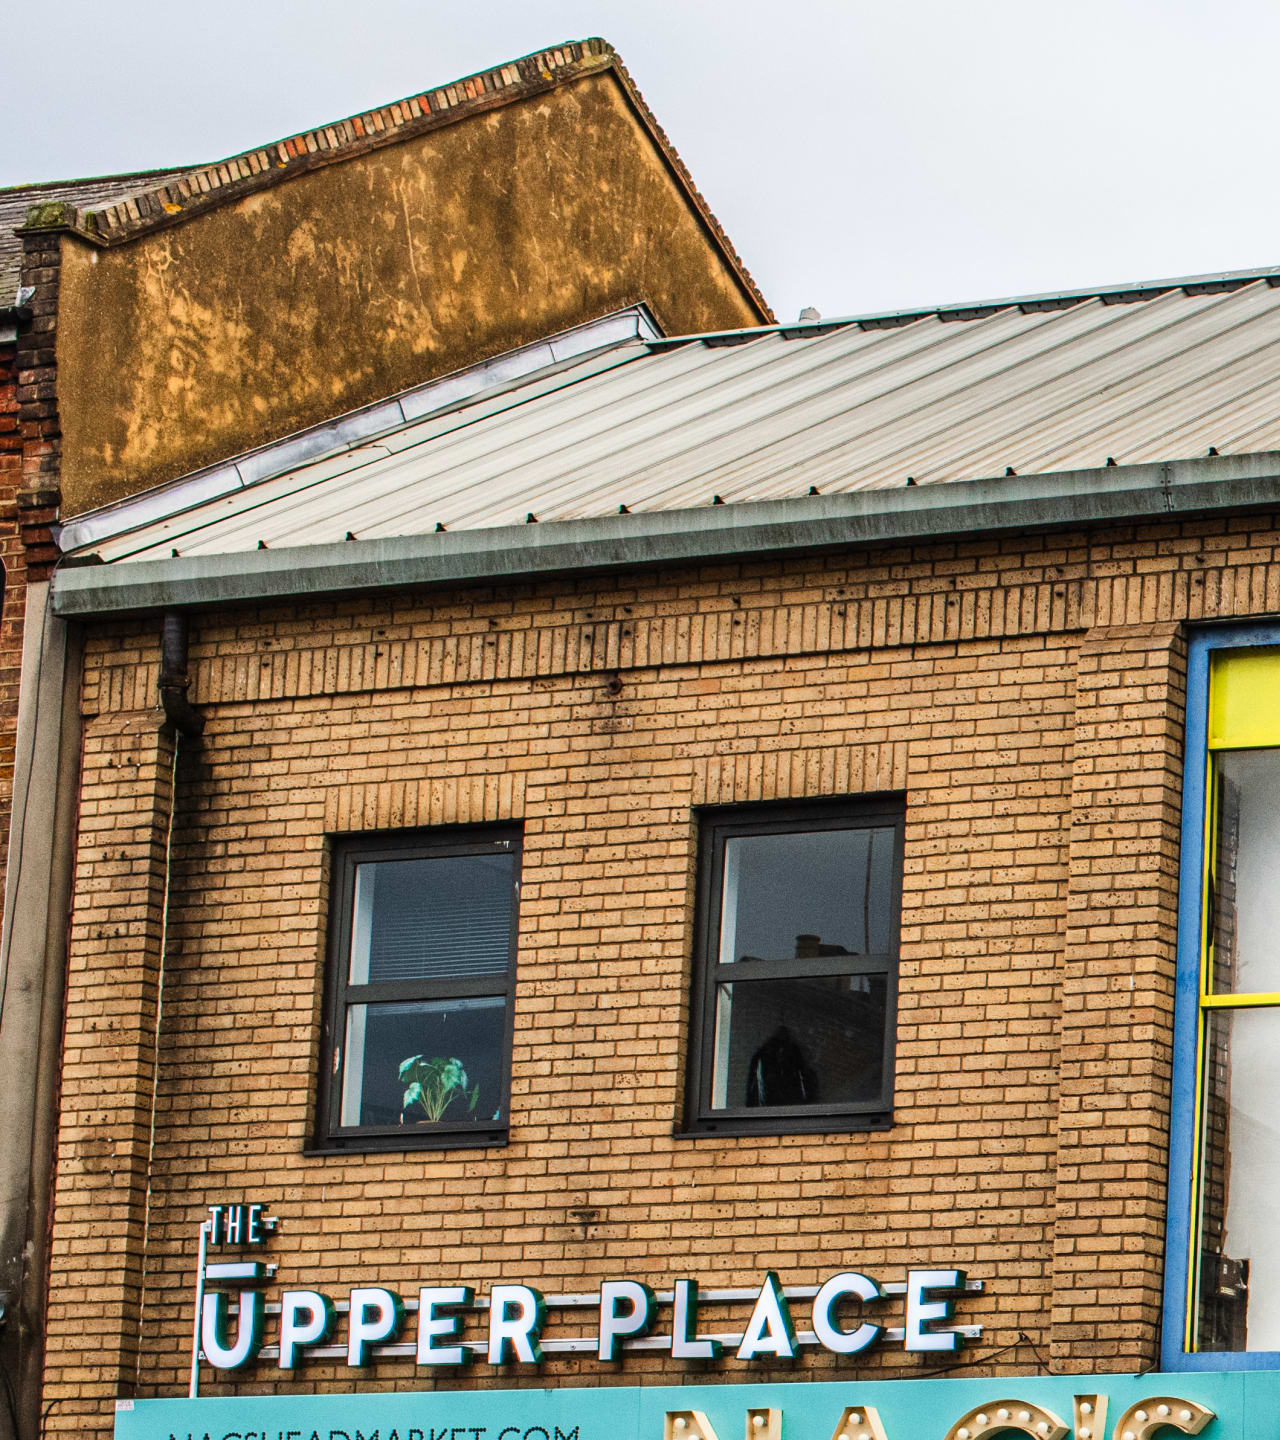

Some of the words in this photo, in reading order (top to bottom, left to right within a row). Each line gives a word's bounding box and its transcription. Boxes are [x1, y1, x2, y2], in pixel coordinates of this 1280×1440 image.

[207, 1204, 263, 1245] THE
[201, 1262, 546, 1370] UPPER
[597, 1268, 968, 1362] PLACE
